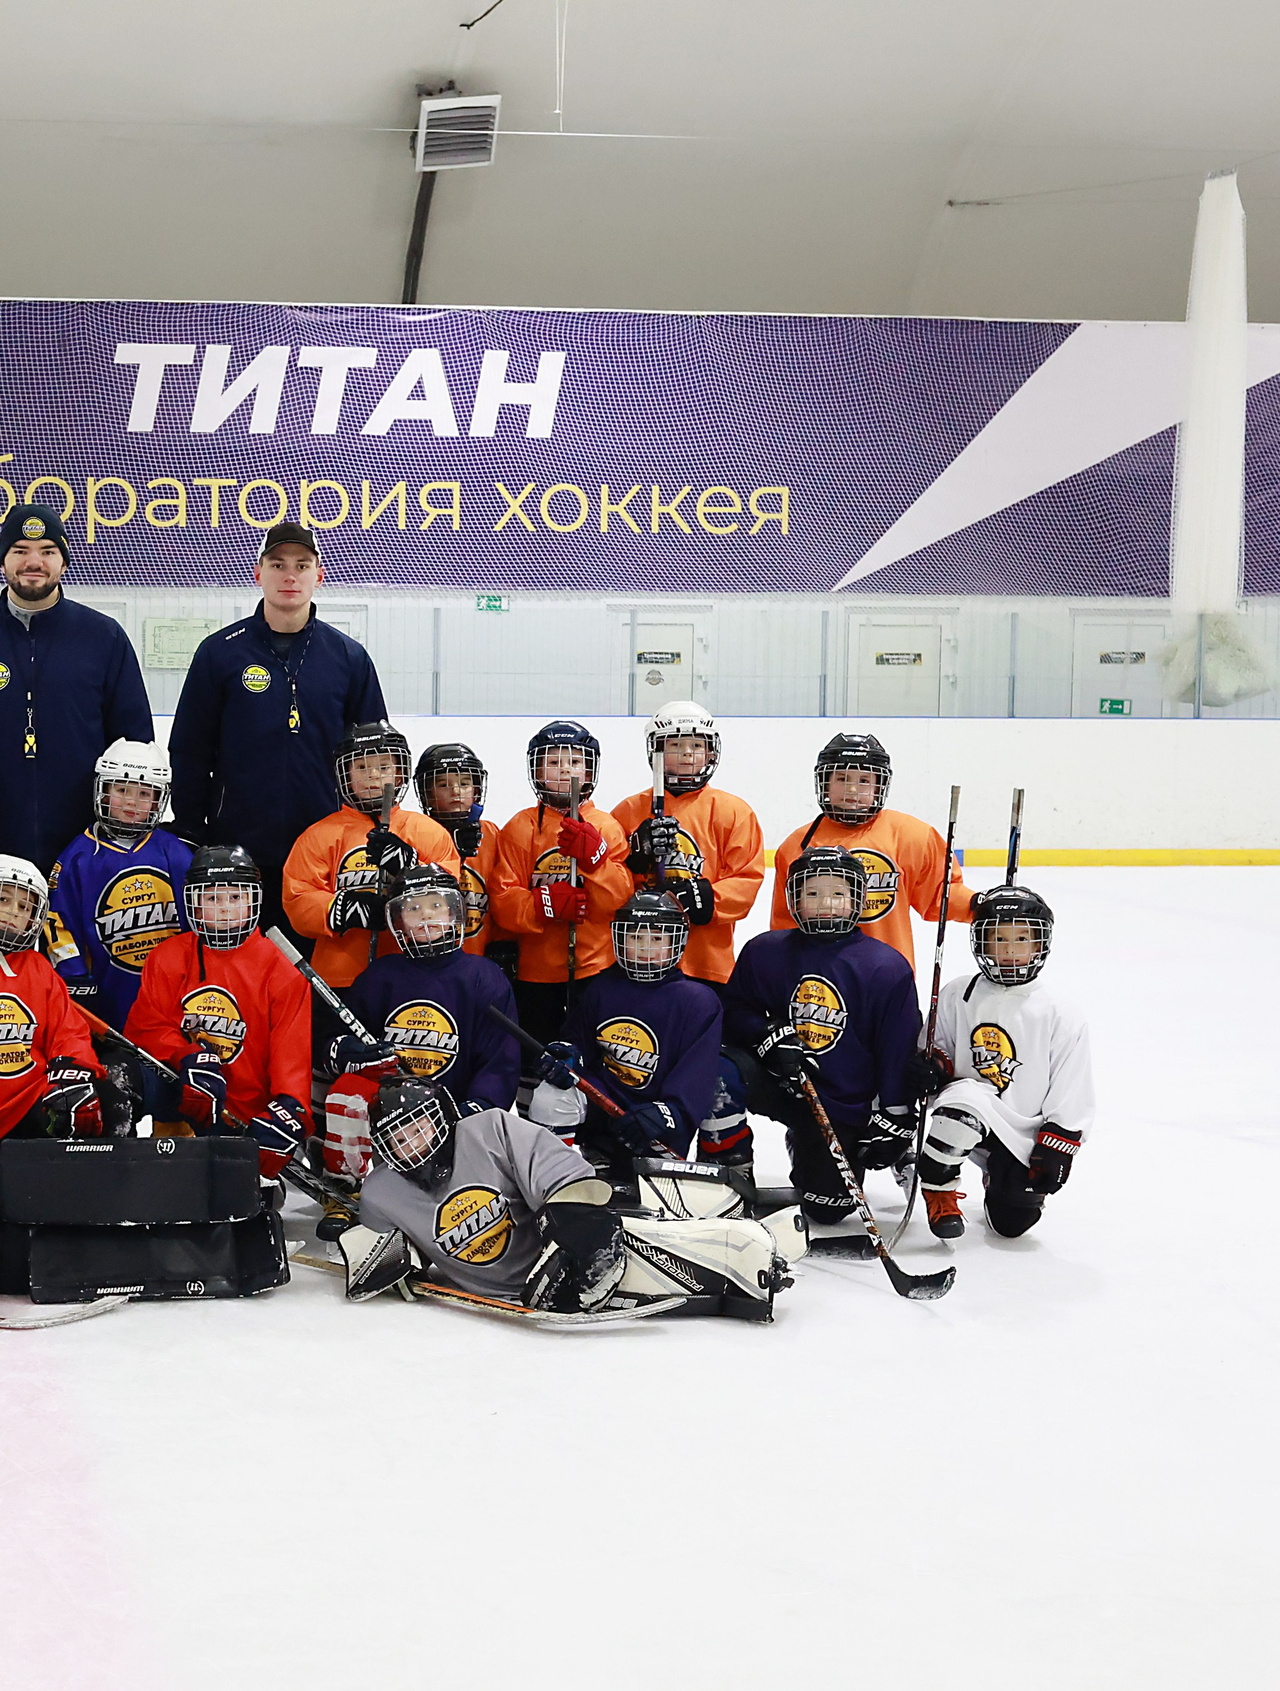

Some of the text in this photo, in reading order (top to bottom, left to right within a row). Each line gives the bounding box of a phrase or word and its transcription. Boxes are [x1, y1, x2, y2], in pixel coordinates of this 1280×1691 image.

[113, 342, 566, 439] ТИТАН
[494, 482, 790, 535] хоккея
[123, 762, 148, 771] BAUER
[208, 867, 235, 876] BAUER
[96, 901, 181, 933] ТИТАН
[196, 1005, 226, 1014] СУРГУТ
[406, 1019, 437, 1028] СУРГУТ
[383, 1026, 459, 1050] ТИТАН
[610, 1034, 641, 1046] СУРГУТ
[267, 1100, 302, 1133] UER
[376, 1106, 404, 1128] BAUER
[65, 1144, 114, 1152] WARRIOR
[661, 1161, 720, 1177] BAUER
[433, 1192, 508, 1251] ТИТАН
[450, 1200, 479, 1222] СУРГУТ
[351, 1235, 386, 1277] BAUER
[95, 1285, 145, 1295] WARRIOR
